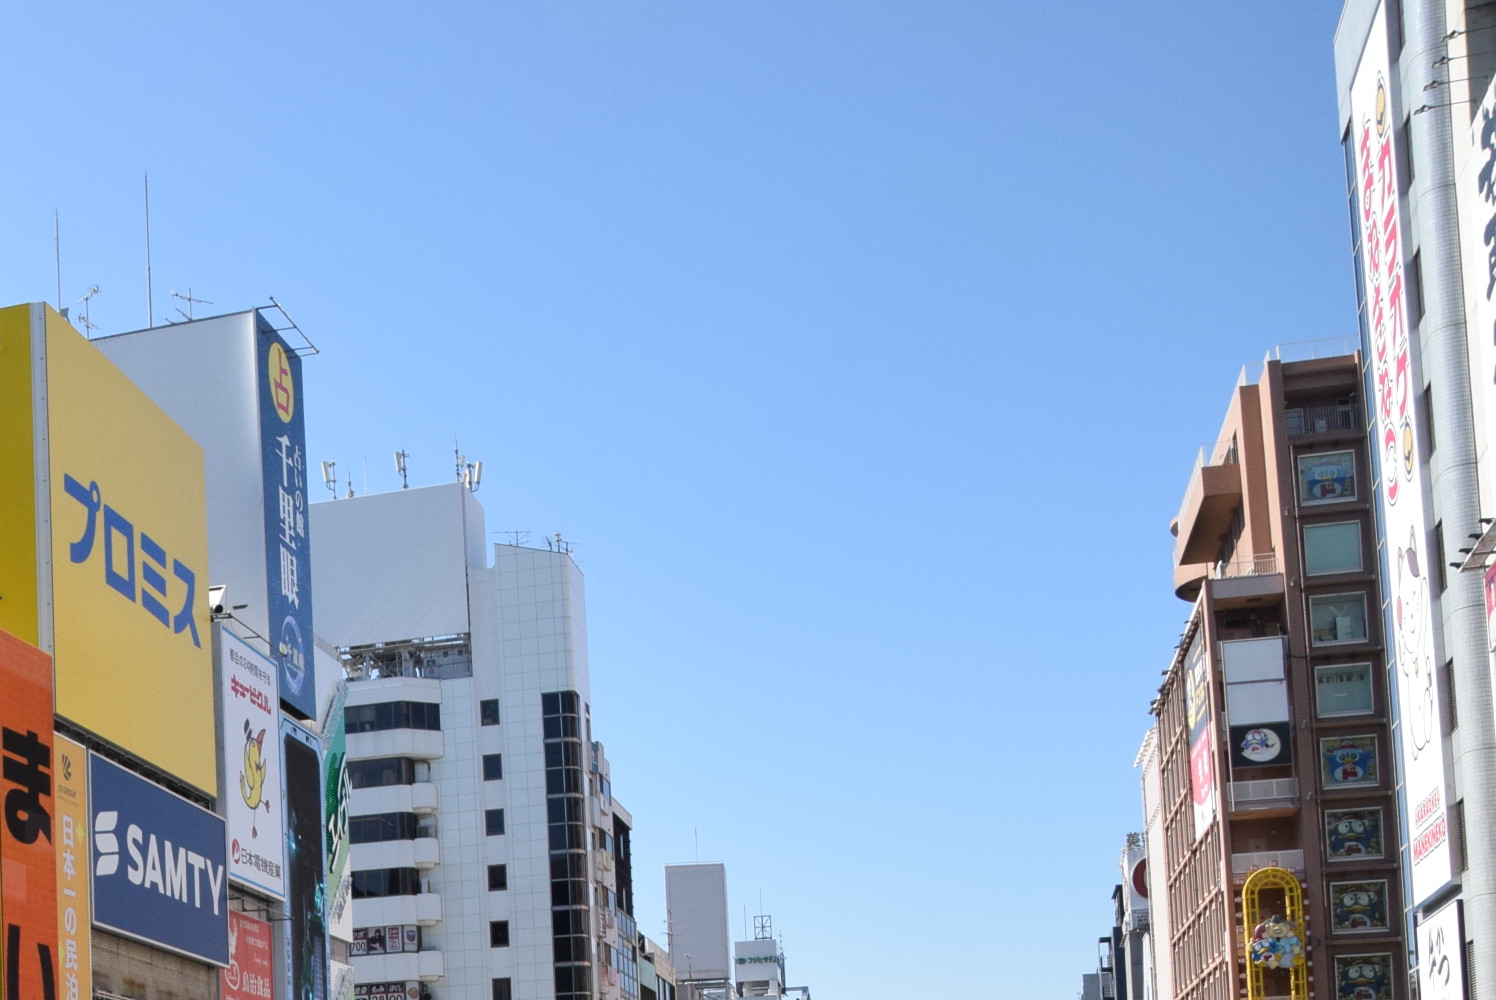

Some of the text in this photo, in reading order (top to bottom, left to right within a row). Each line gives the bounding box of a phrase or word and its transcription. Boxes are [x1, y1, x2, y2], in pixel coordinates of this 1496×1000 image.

[1360, 122, 1399, 504] まねきねこ
[1377, 136, 1408, 422] カラオケ
[273, 347, 292, 417] 占
[63, 472, 202, 650] プロミス
[275, 433, 300, 611] 千里眼
[231, 674, 272, 715] キュービクル
[125, 823, 224, 916] SAMTY
